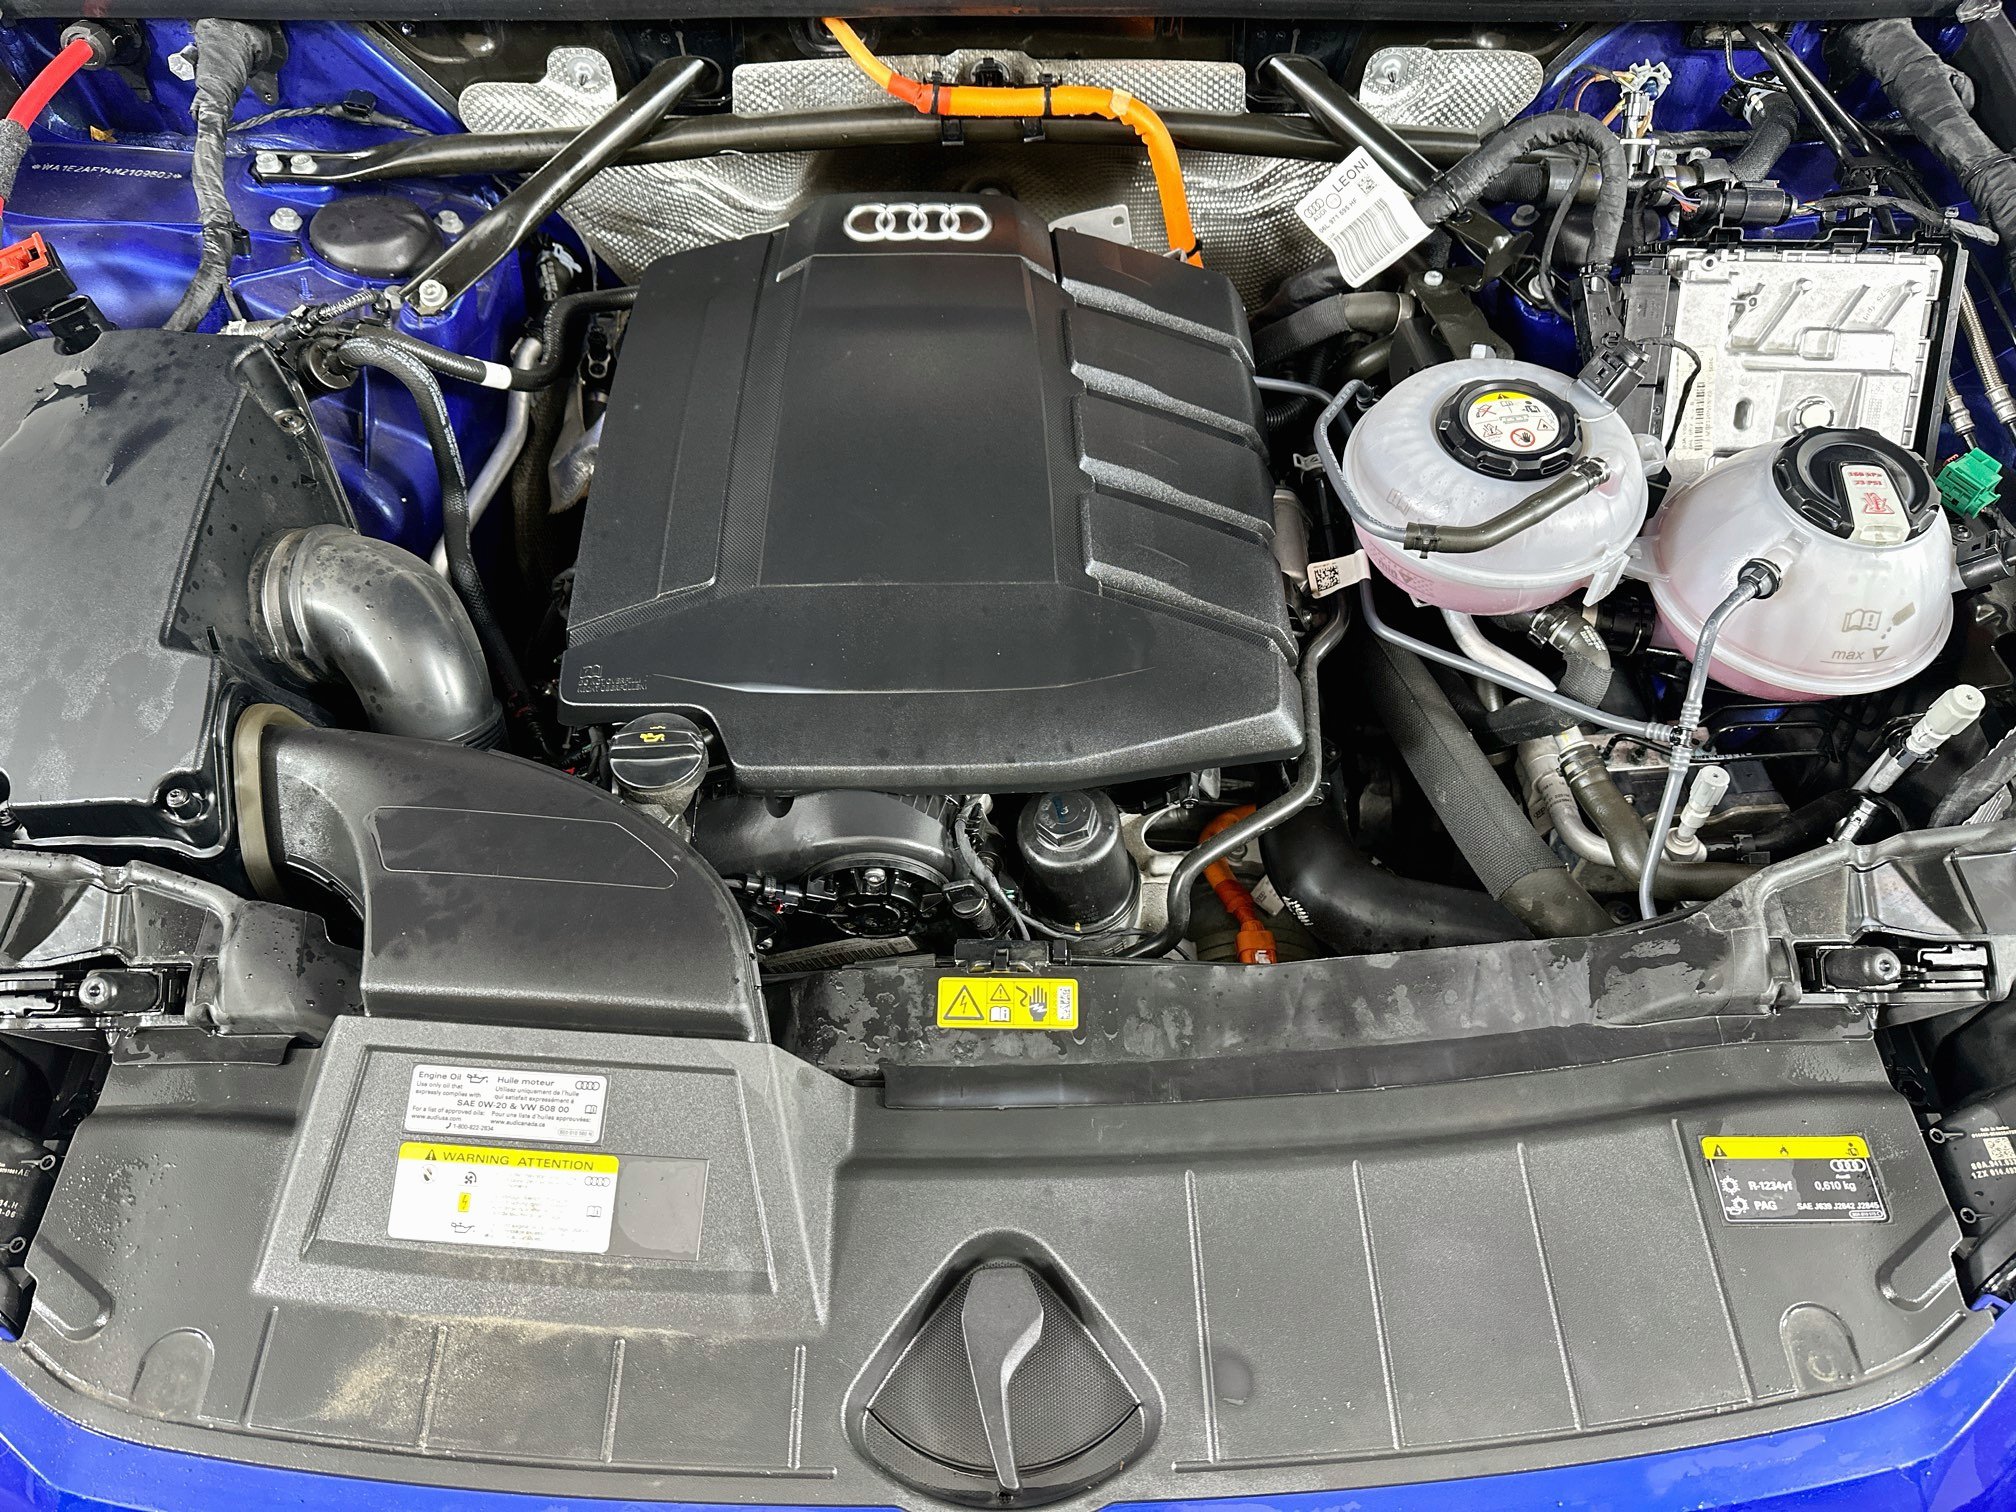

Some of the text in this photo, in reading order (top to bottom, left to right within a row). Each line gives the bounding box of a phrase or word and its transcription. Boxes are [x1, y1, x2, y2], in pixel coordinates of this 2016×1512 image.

[1332, 158, 1368, 192] LEONI
[1313, 209, 1328, 222] AUDI
[1329, 214, 1340, 225] 971
[1832, 650, 1864, 660] max
[418, 1071, 447, 1080] Engine
[517, 1087, 552, 1095] uniquement
[478, 1100, 507, 1109] 0W-20
[490, 1119, 545, 1128] www.audicanada.ca
[442, 1151, 594, 1171] WARNING ATTENTION
[1748, 1180, 1857, 1193] R-1234yf 0,610 kg
[1753, 1201, 1778, 1210] PAG
[1857, 1202, 1879, 1210] J2845
